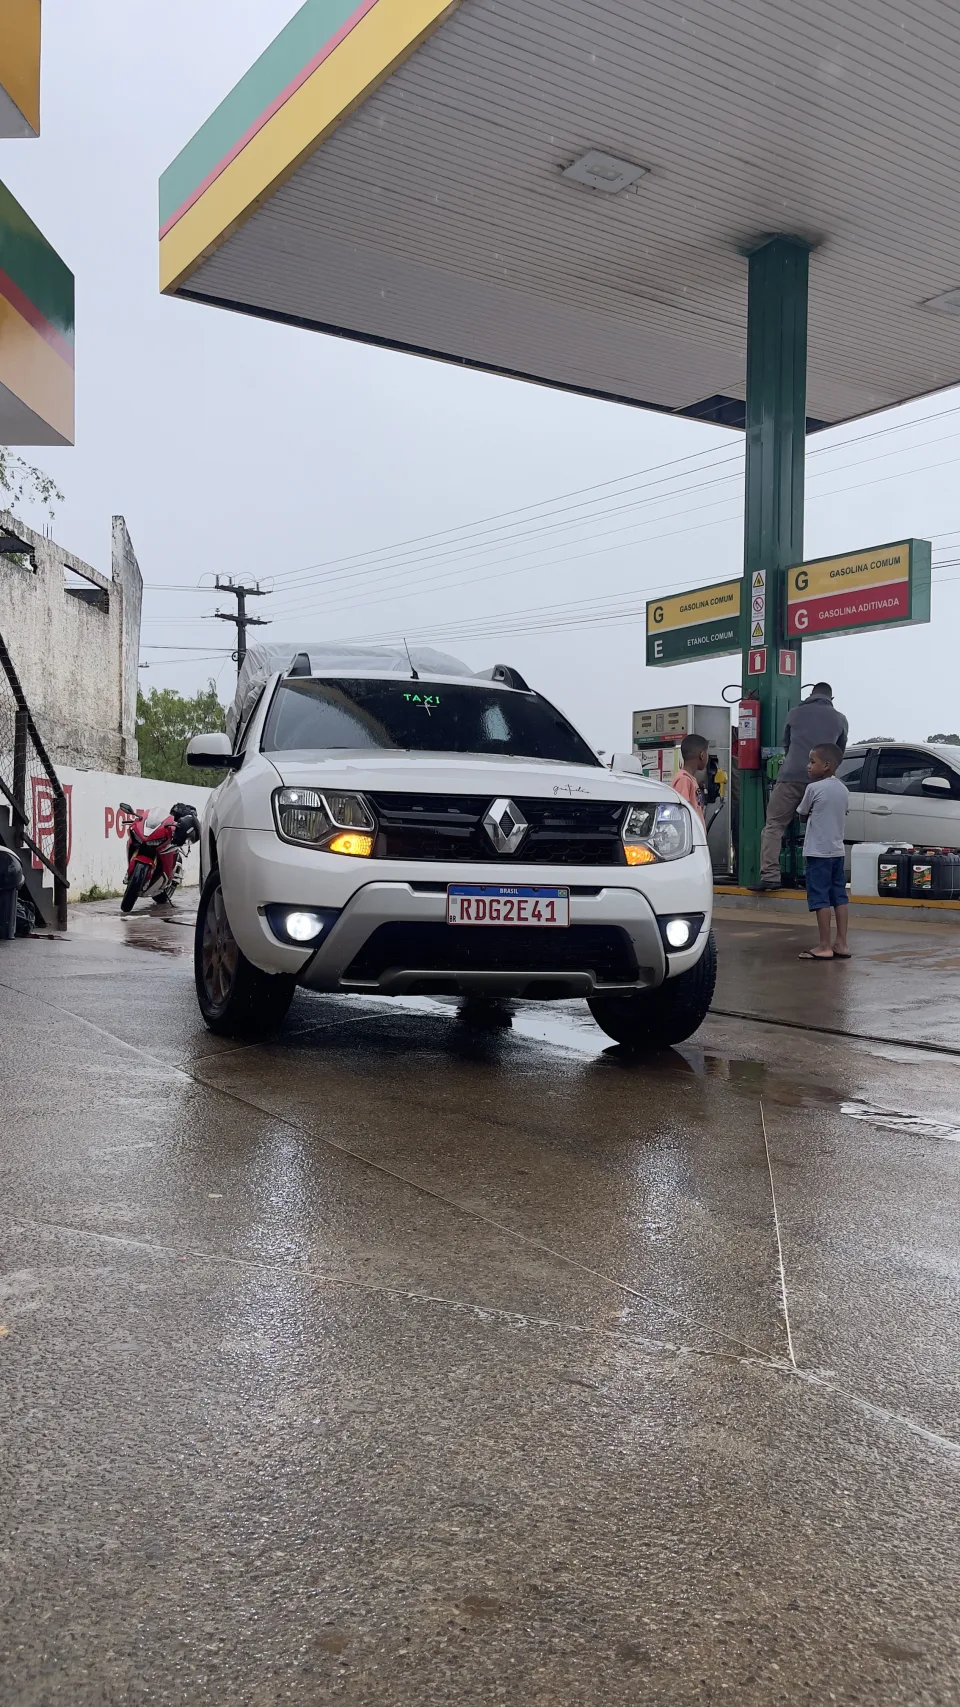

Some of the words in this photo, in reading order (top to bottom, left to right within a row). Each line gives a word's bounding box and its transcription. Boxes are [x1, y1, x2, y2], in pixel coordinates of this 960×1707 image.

[795, 571, 808, 591] G
[829, 564, 868, 578] GASOLINA
[870, 556, 901, 569] COMUM
[653, 606, 664, 623] G
[680, 600, 709, 612] GASOLINA
[710, 594, 734, 606] COMUM
[794, 609, 809, 629] G
[818, 605, 857, 619] GASOLINA
[857, 598, 900, 613] ADITIVADA
[654, 640, 664, 658] E
[687, 636, 710, 647] ETANOL
[710, 630, 734, 642] COMUM
[403, 693, 440, 704] TAXI
[499, 887, 519, 895] BRASIL
[460, 898, 557, 923] RDG2E41
